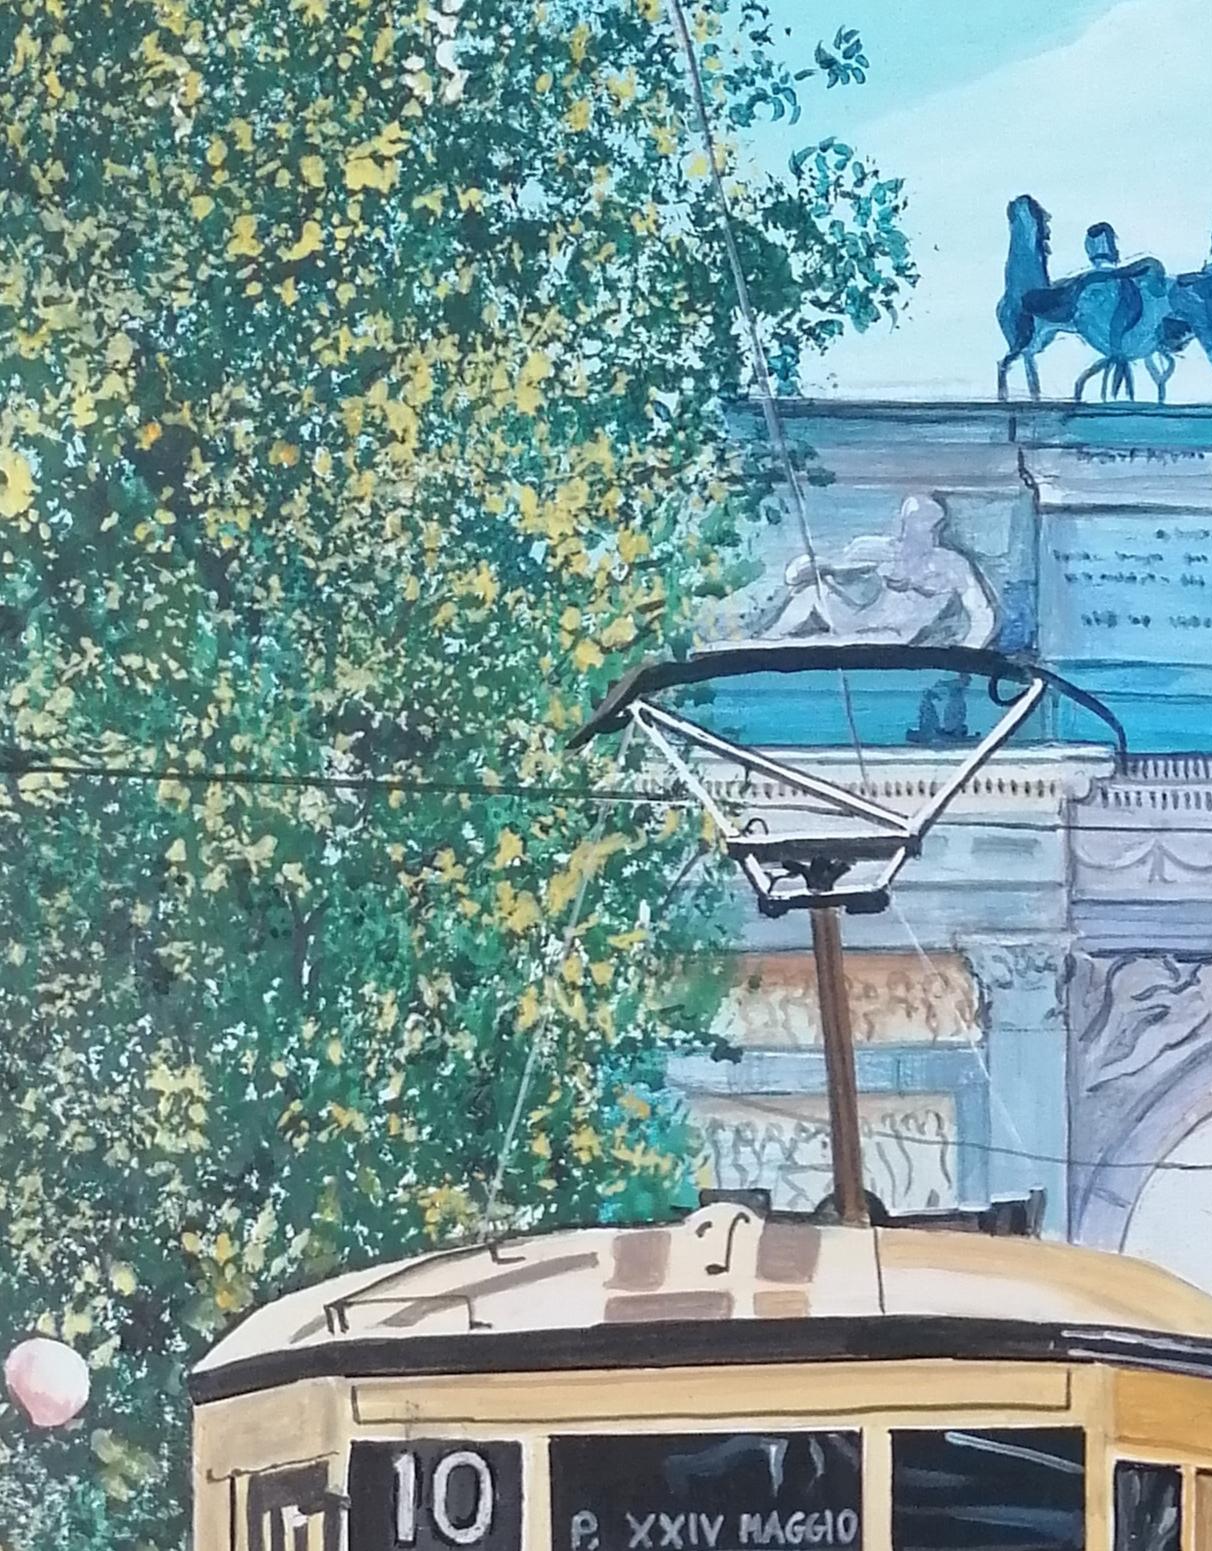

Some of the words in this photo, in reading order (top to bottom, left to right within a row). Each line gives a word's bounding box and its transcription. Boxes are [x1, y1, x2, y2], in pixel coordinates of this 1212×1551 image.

[393, 1450, 494, 1545] 10
[570, 1510, 600, 1551] P.
[625, 1511, 725, 1549] XXIV
[739, 1508, 858, 1544] MAGGIO
